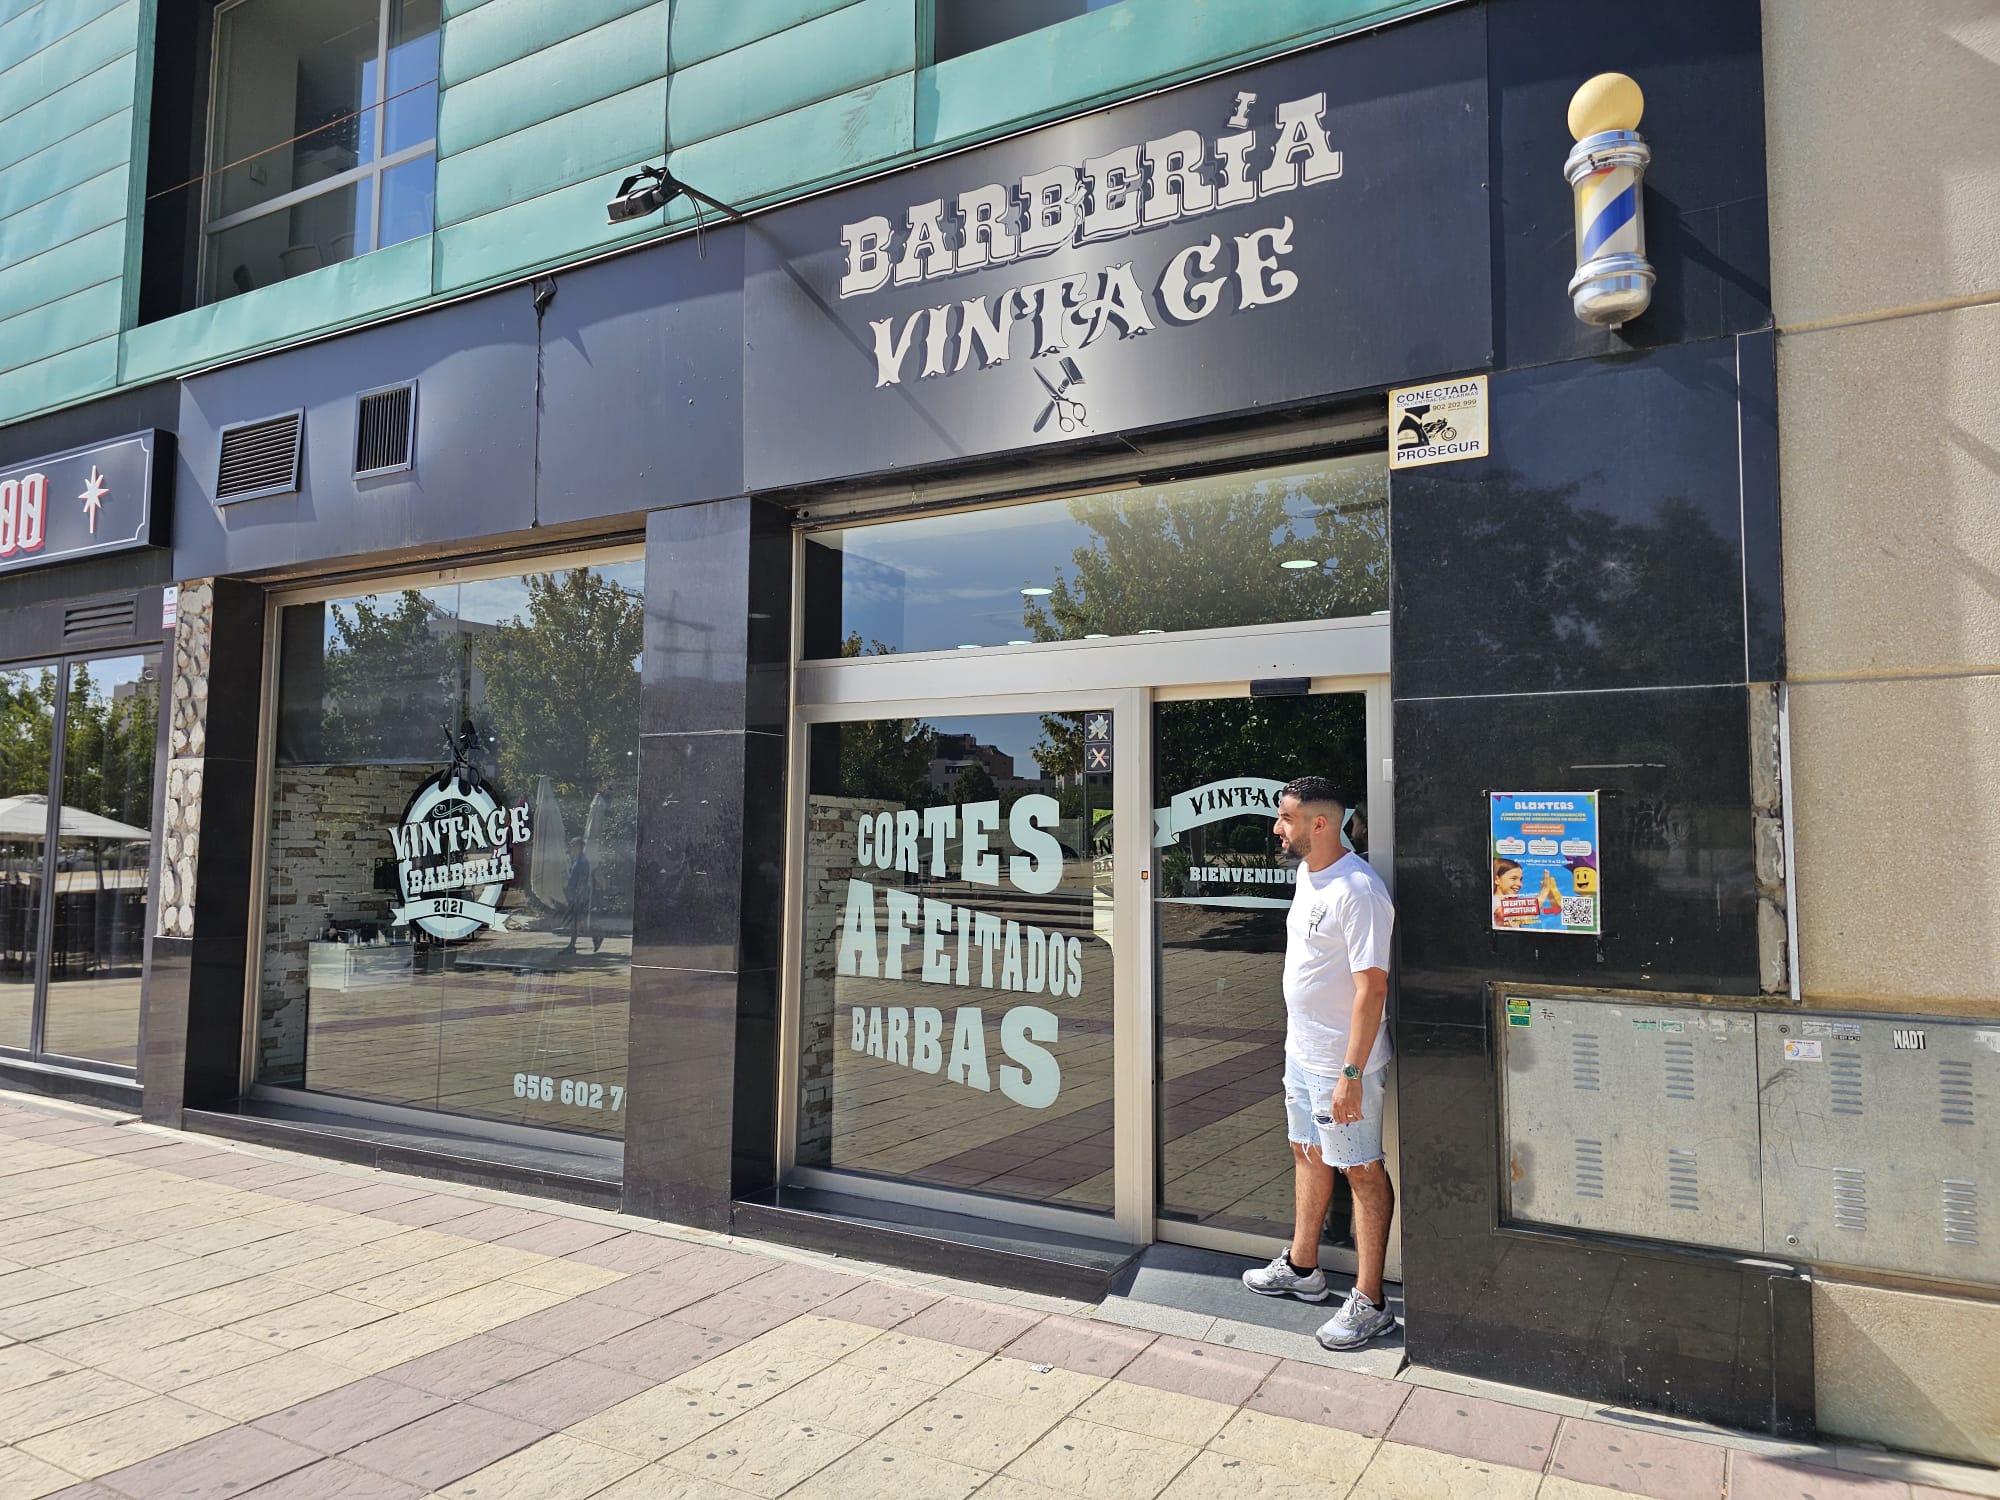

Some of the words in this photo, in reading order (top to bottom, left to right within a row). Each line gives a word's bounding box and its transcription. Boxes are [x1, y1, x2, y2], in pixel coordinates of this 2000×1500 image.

[839, 91, 1342, 299] BARBERÍA
[868, 216, 1300, 388] VINTAGE
[1396, 383, 1478, 403] CONECTADA
[1447, 401, 1461, 409] 202
[1397, 440, 1480, 461] PROSEGUR
[388, 801, 532, 861] VINTAGE
[857, 794, 1064, 894] CORTES
[408, 849, 515, 895] BARBERÍA
[433, 899, 464, 915] 2021
[838, 878, 1083, 998] AFEITADOS
[851, 1005, 1062, 1109] BARBAS
[1893, 1029, 1926, 1049] NADT
[513, 1072, 554, 1102] 656
[560, 1079, 604, 1109] 602
[610, 1085, 627, 1112] 7
